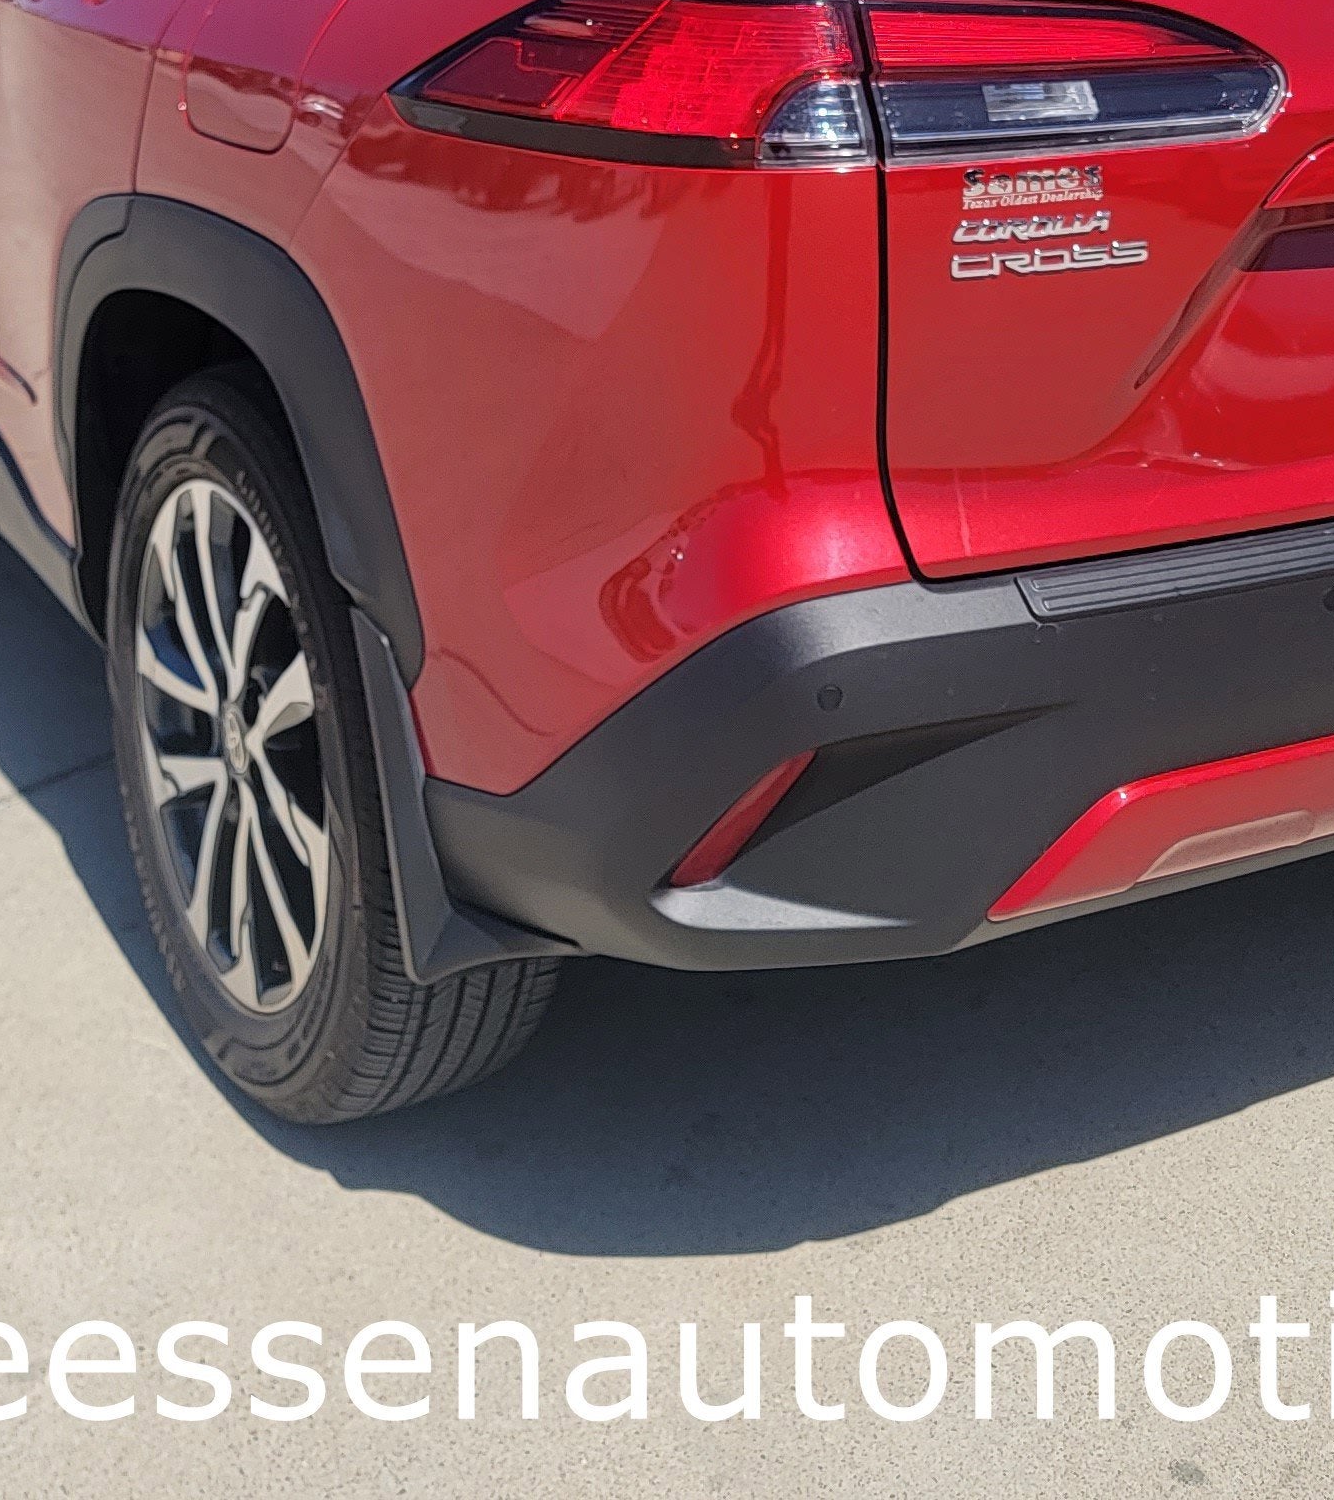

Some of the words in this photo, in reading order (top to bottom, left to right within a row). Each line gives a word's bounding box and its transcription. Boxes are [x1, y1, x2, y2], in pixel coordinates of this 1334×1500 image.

[962, 165, 1103, 197] Sames
[962, 197, 999, 210] Texas
[1000, 194, 1039, 207] Oldest
[1040, 188, 1104, 204] Dealership
[953, 211, 1110, 243] COROLLA
[951, 241, 1149, 279] CROSS
